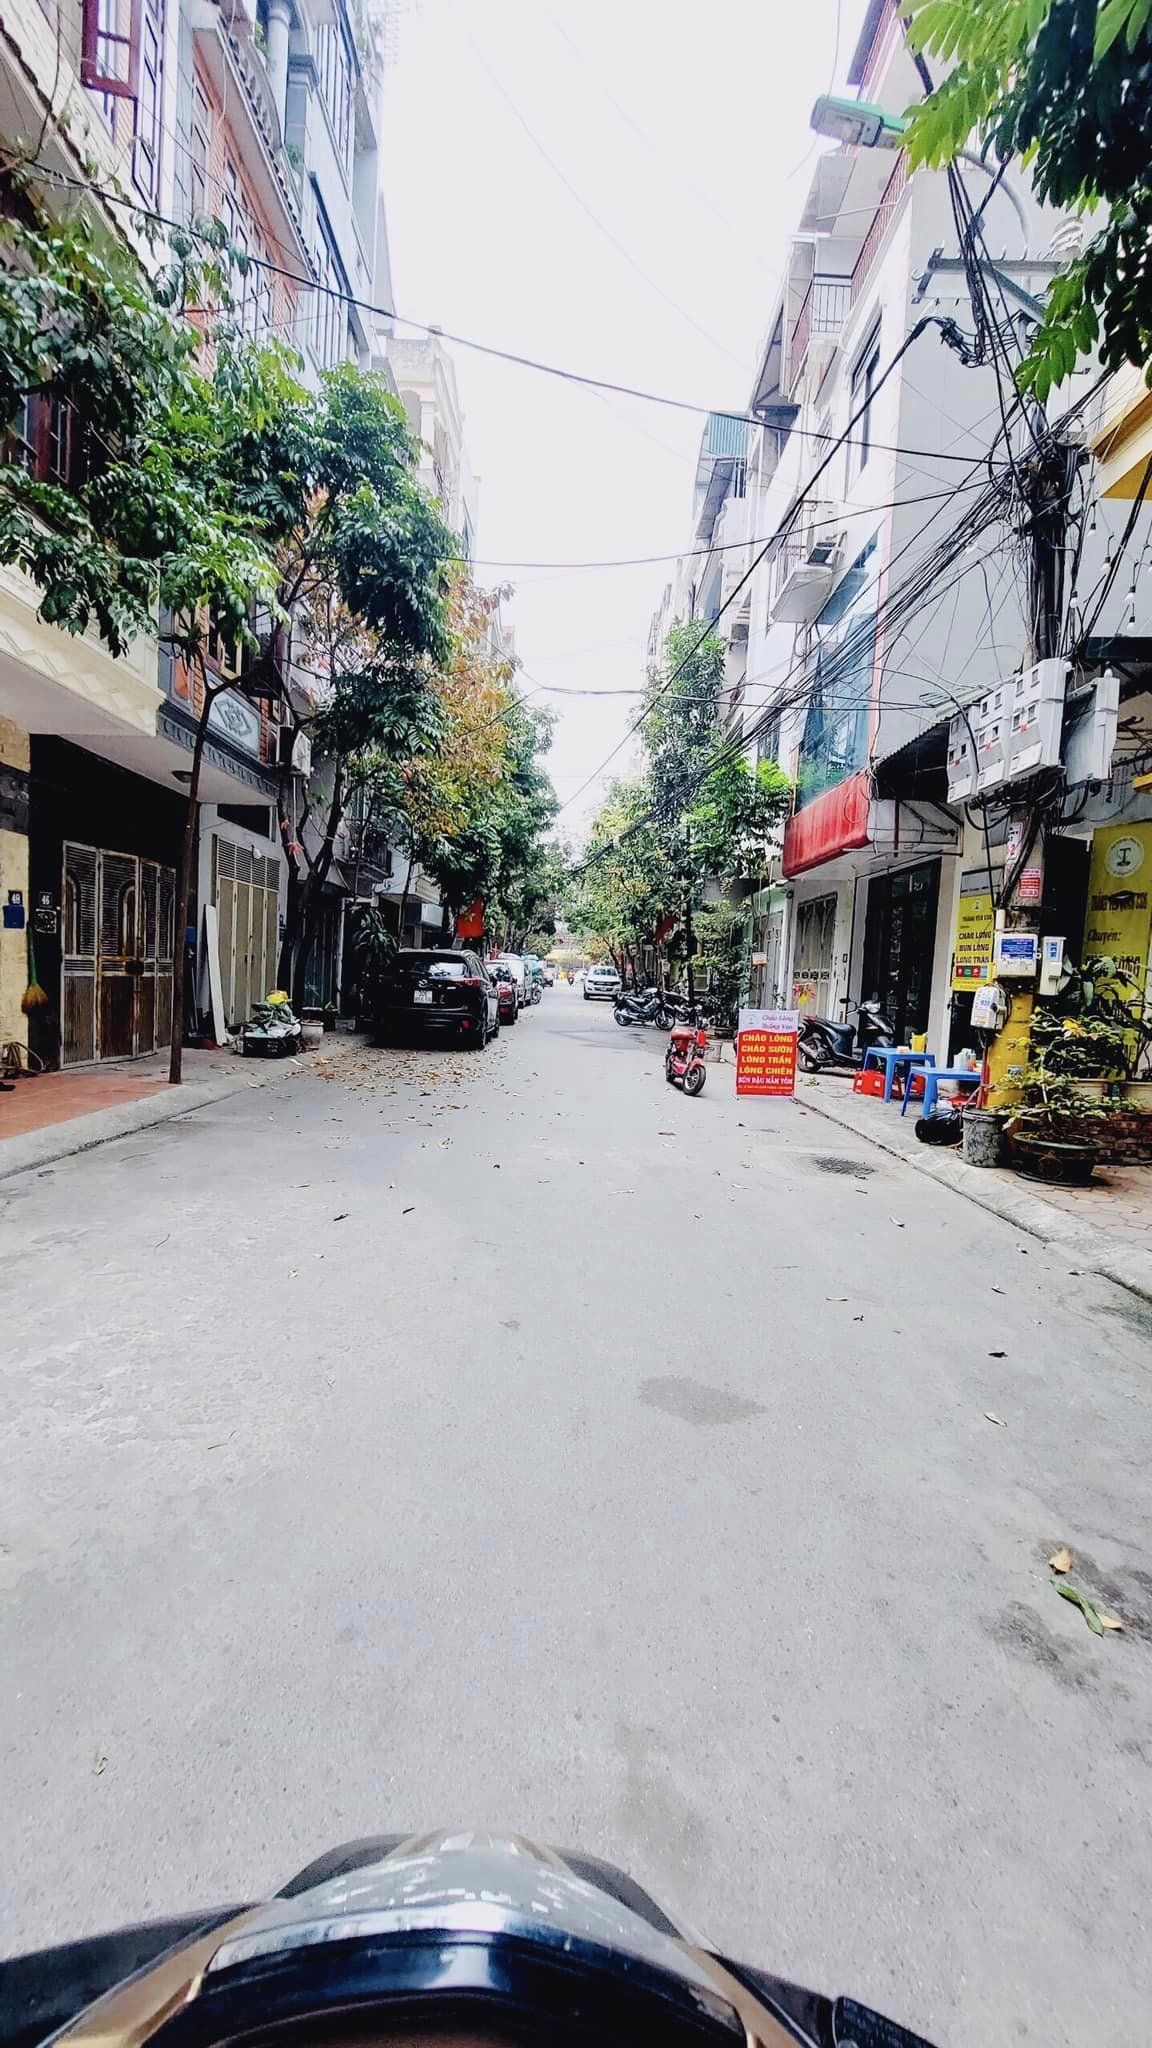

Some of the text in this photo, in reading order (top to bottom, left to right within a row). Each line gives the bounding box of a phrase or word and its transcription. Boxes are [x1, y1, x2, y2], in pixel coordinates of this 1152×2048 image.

[12, 893, 20, 904] 48
[742, 1034, 793, 1042] CHÁO LÒNG
[741, 1044, 766, 1052] CHÁO
[742, 1056, 766, 1064] LÒNG
[739, 1066, 763, 1074] LÒNG
